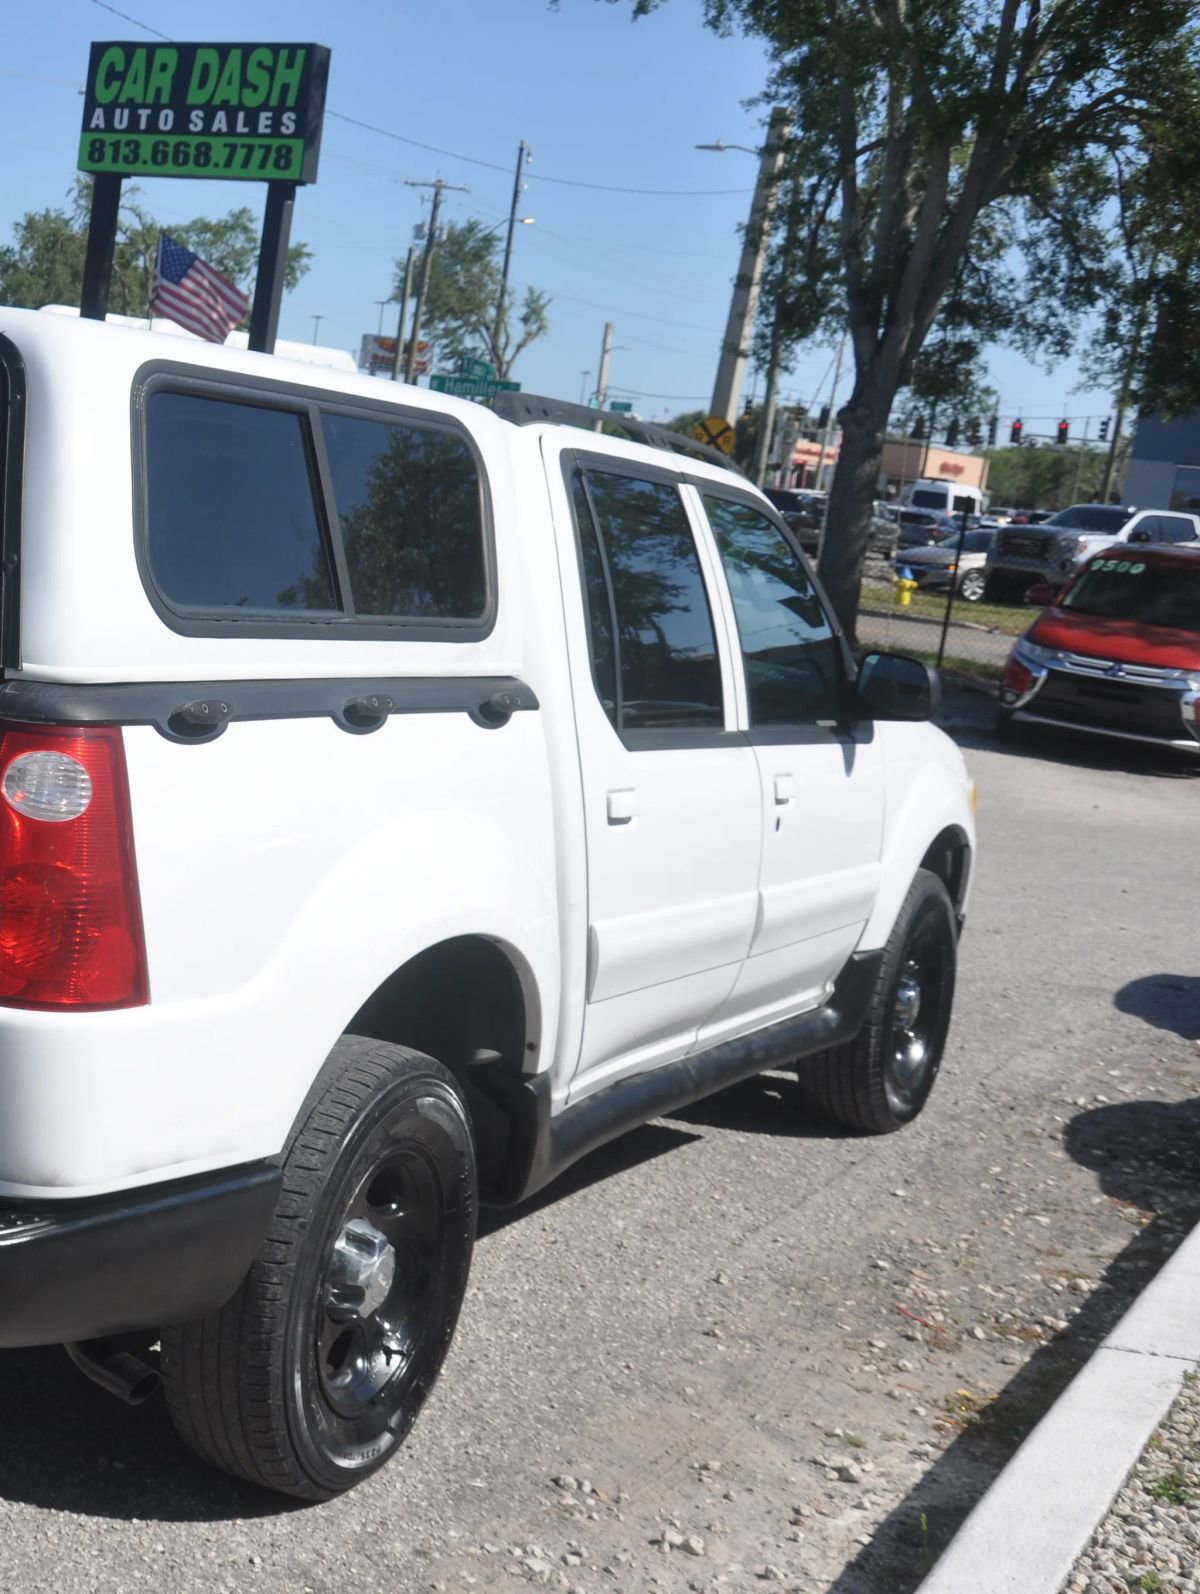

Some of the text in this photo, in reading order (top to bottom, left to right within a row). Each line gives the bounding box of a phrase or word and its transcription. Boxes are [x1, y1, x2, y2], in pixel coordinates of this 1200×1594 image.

[94, 46, 307, 108] CAR DASH
[89, 107, 297, 135] AUTO SALES
[87, 137, 294, 172] 813.668.7778
[1090, 559, 1146, 575] 9500
